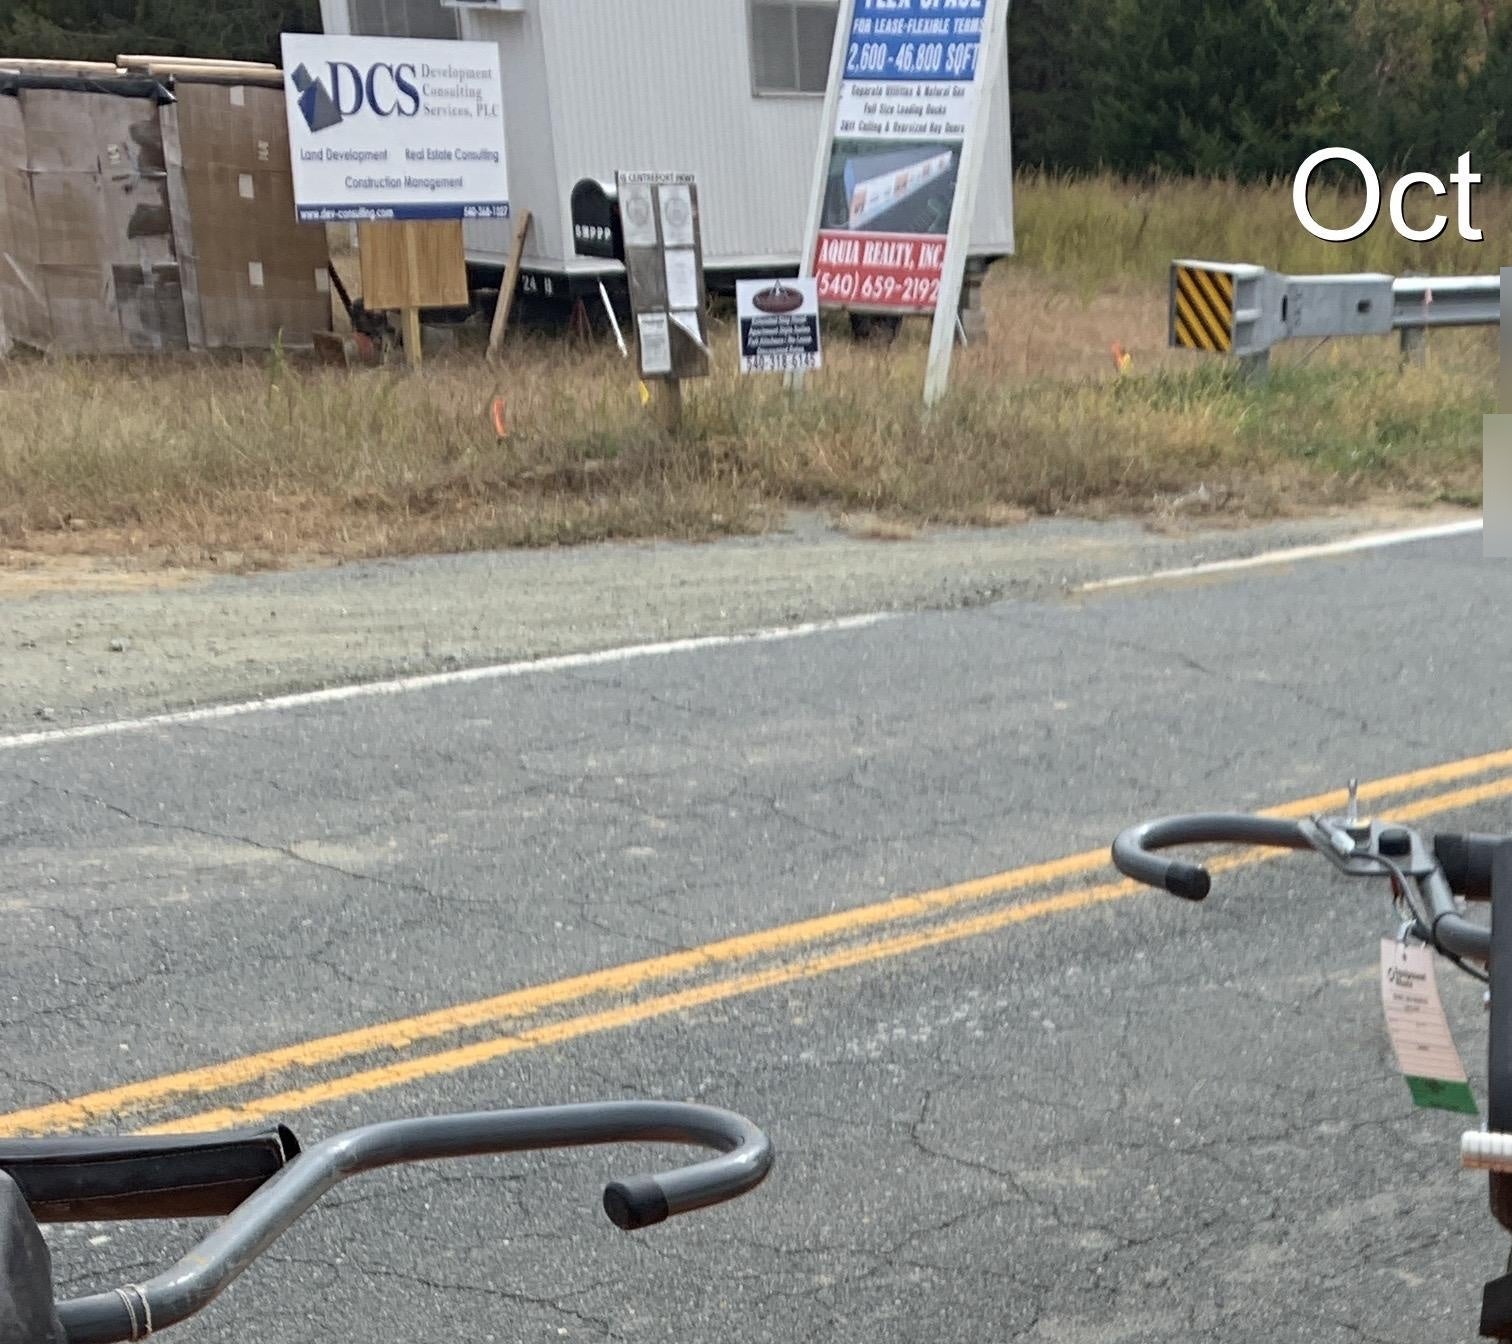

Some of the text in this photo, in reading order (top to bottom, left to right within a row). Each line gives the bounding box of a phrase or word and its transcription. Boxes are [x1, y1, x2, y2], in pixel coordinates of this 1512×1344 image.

[852, 17, 872, 34] FOR
[847, 43, 888, 73] 2,600
[895, 43, 943, 72] 46,800
[945, 43, 981, 75] SQFT
[421, 63, 492, 83] Development
[326, 60, 421, 118] DCS
[422, 83, 482, 99] Consulting
[924, 85, 950, 97] Natural
[952, 86, 965, 97] Gas
[423, 103, 499, 118] Services, PLC
[863, 102, 877, 114] Full
[879, 103, 895, 114] Size
[897, 103, 924, 116] Loading
[300, 148, 388, 163] Land Development
[405, 148, 499, 163] Real Estate Consulting
[344, 175, 463, 190] Construction Management
[818, 238, 860, 266] AQUIA
[862, 239, 914, 269] REALTY,
[816, 268, 940, 302] (540) 659-2192
